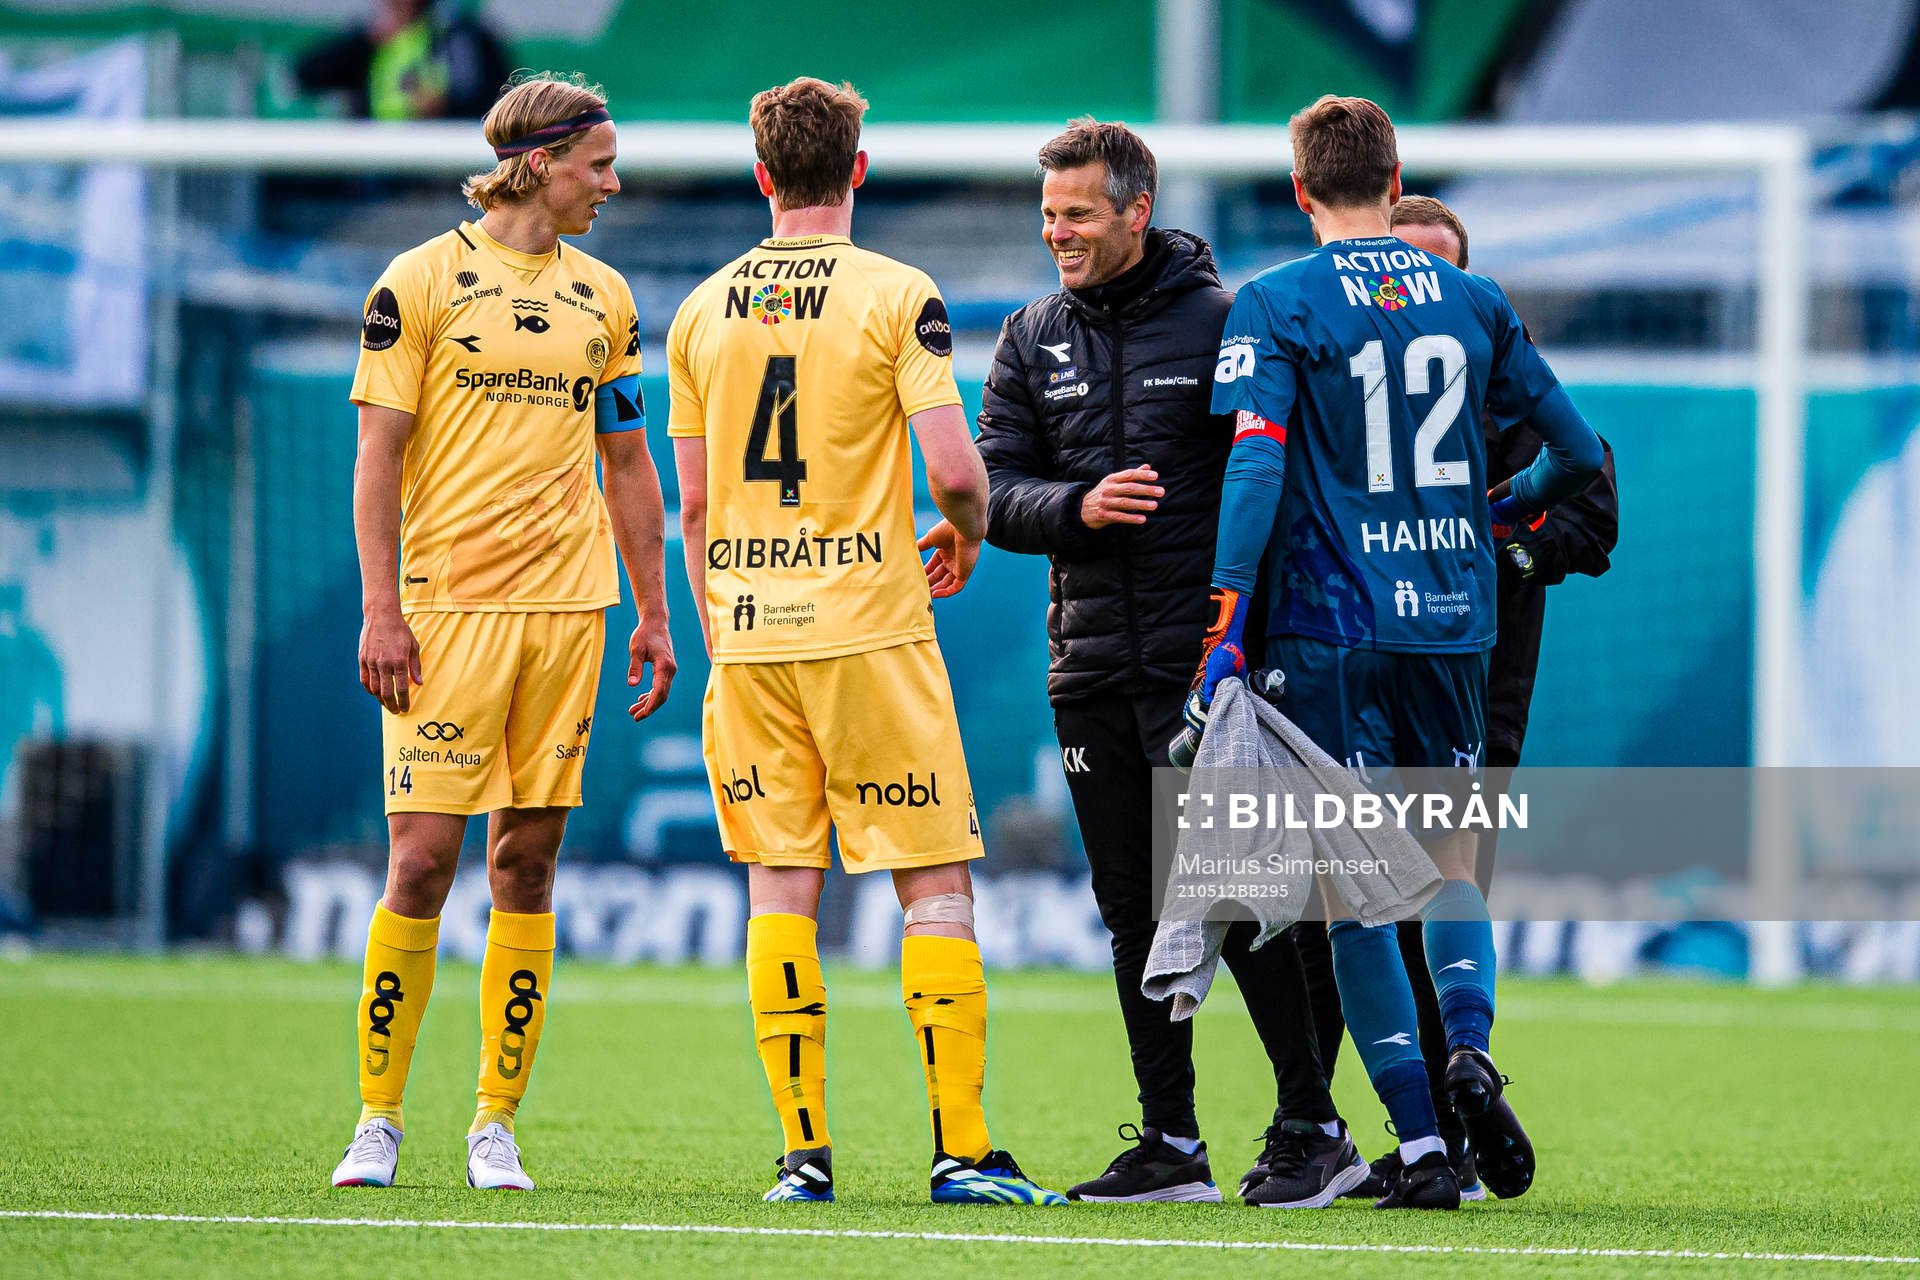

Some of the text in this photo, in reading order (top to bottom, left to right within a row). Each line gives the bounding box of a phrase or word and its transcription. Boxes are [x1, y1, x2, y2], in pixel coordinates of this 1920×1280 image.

[732, 258, 837, 280] ACTION
[1332, 249, 1432, 273] ACTION
[473, 284, 503, 298] Energi
[554, 291, 606, 322] Bodø Energi
[455, 368, 569, 393] SpareBank
[1044, 384, 1077, 398] SpareBank
[1143, 379, 1153, 387] FK
[485, 391, 569, 408] NORD-NORGE
[1350, 335, 1471, 493] 12
[743, 355, 808, 508] 4
[1361, 517, 1476, 553] HAIKIN
[708, 528, 882, 570] ØIBRÅTEN
[1424, 591, 1469, 602] Barnekreft
[763, 603, 815, 614] Barnekreft
[1427, 603, 1471, 615] foreningen
[763, 615, 815, 627] foreningen
[399, 746, 481, 768] Salten Aqua
[1061, 747, 1090, 772] KK
[389, 765, 413, 796] 14
[856, 773, 941, 807] nobl
